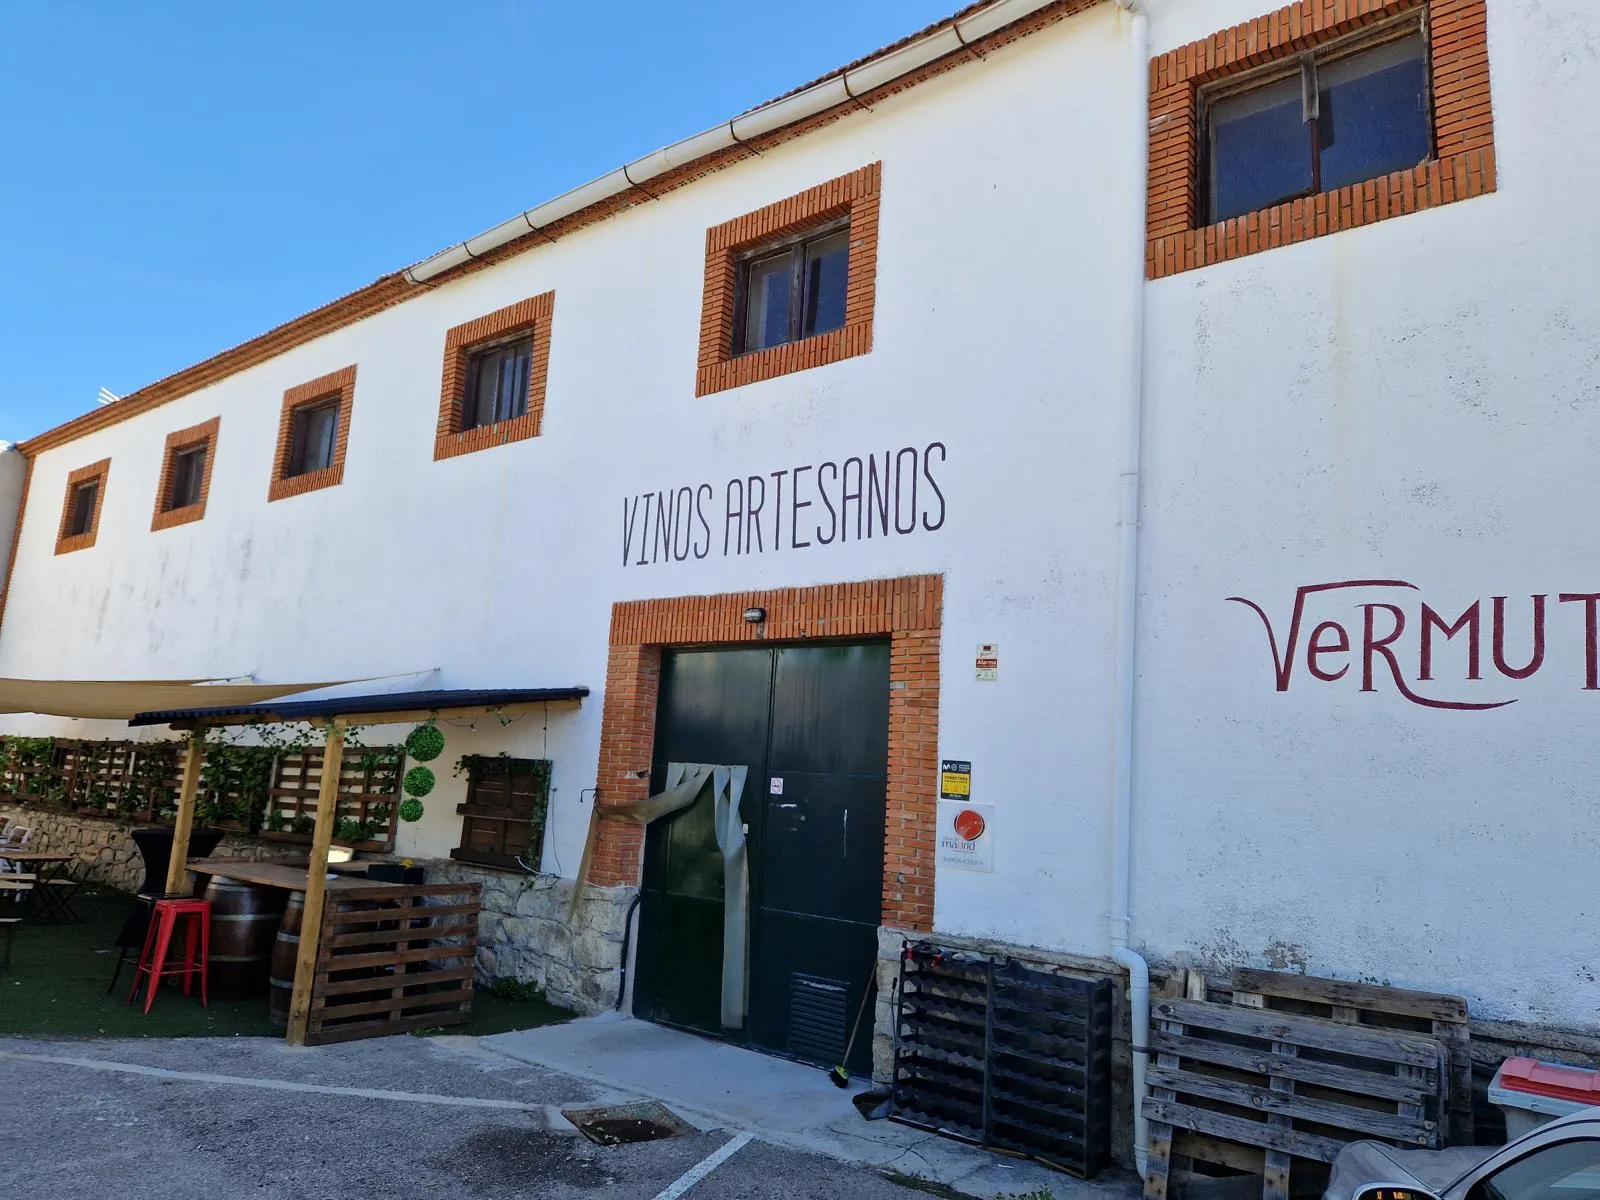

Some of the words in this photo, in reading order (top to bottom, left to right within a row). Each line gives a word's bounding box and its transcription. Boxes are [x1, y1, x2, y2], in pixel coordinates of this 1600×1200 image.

[623, 483, 713, 567] VINOS
[724, 441, 947, 556] ARTESANOS
[942, 841, 976, 851] madrid
